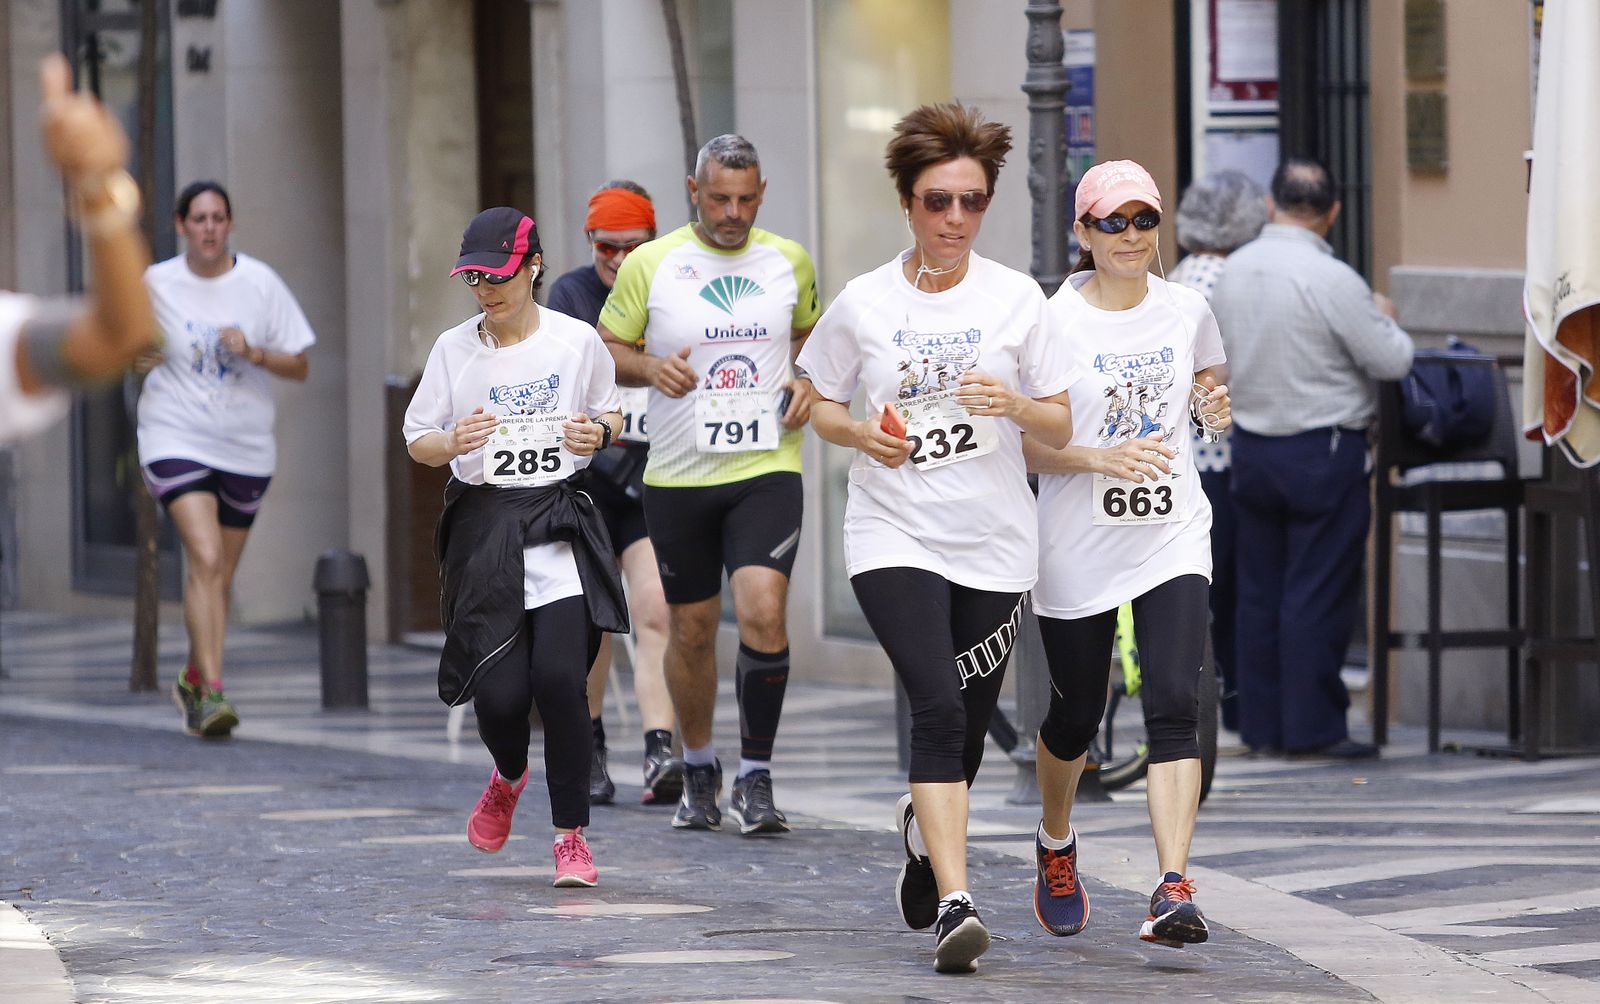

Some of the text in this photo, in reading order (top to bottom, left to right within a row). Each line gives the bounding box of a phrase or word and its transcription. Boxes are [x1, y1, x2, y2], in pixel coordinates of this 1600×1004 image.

[705, 322, 767, 341] Unicaja
[716, 368, 736, 389] 38
[894, 398, 928, 410] CARRERA
[704, 419, 759, 446] 791
[906, 423, 978, 465] 232
[493, 446, 562, 476] 285
[1103, 485, 1173, 518] 663
